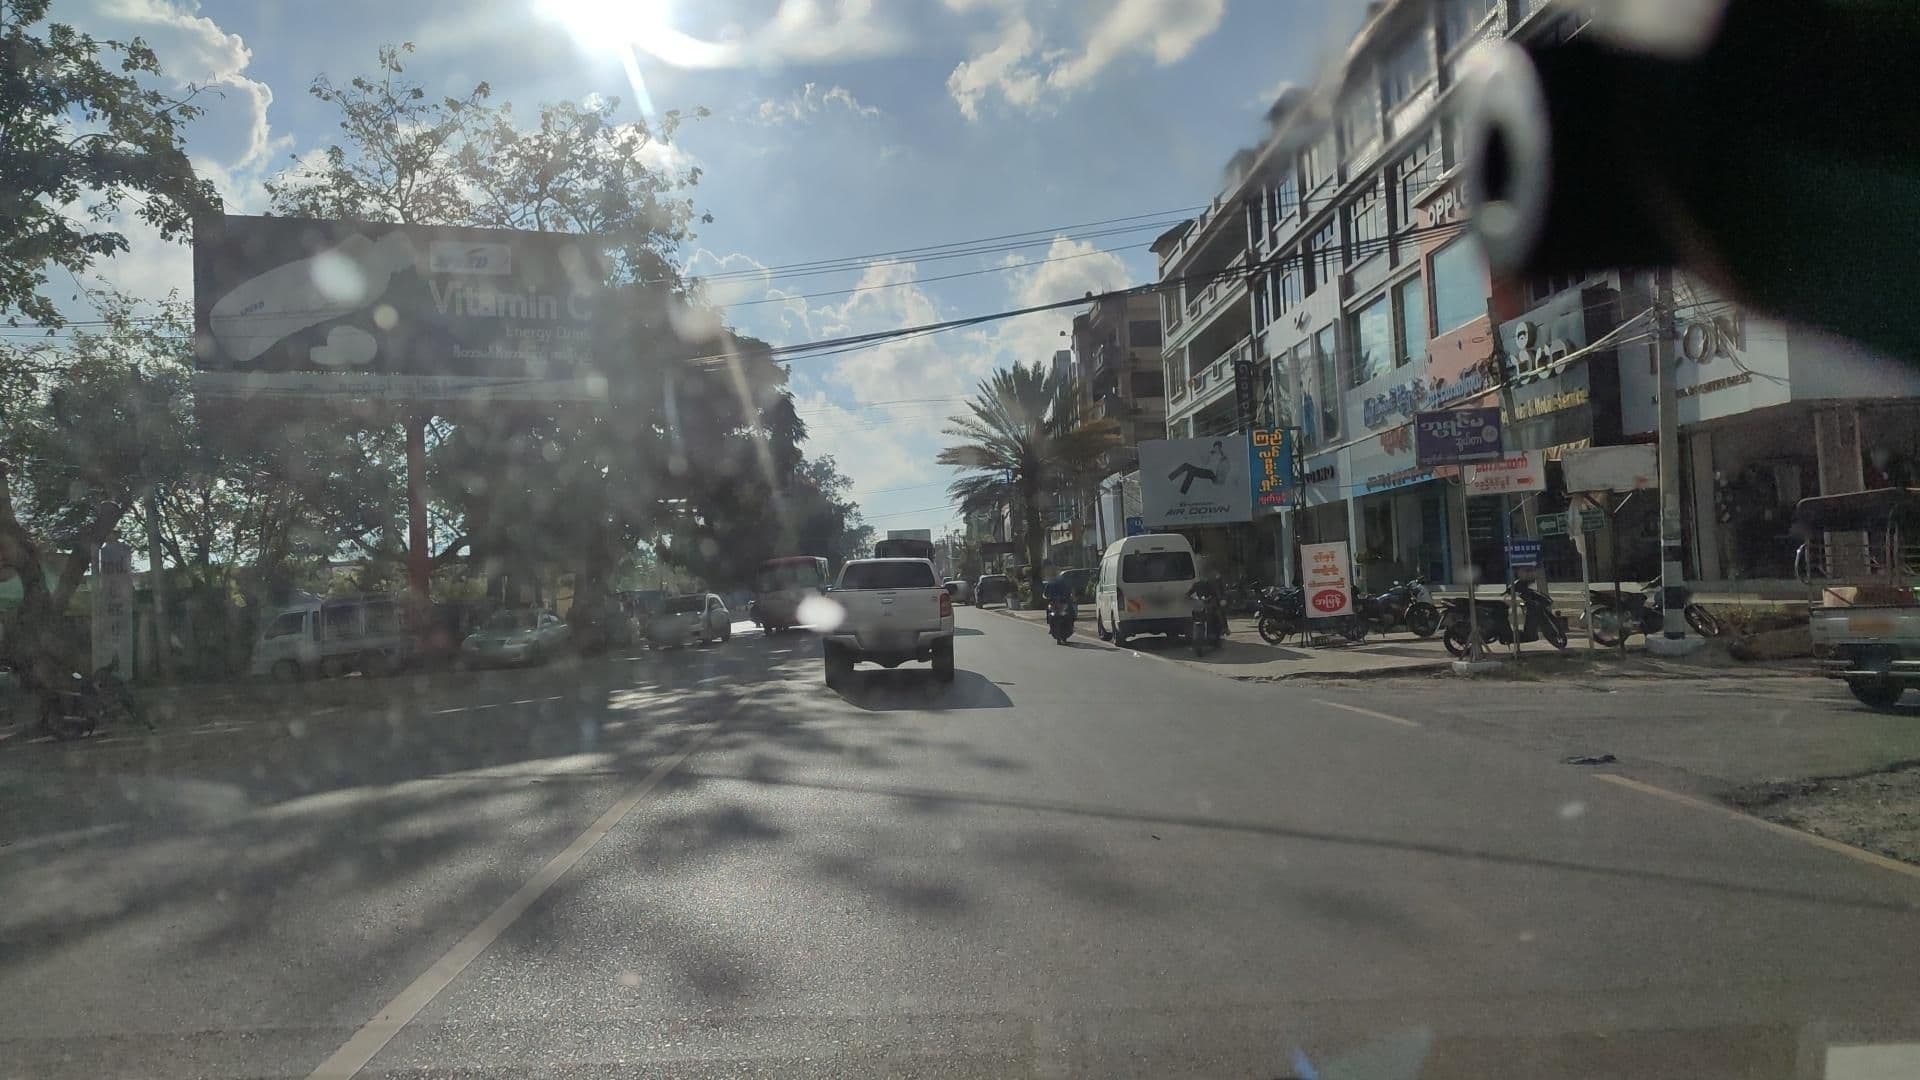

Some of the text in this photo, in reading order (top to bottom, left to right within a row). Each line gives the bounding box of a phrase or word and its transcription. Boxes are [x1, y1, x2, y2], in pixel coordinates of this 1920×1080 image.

[428, 279, 593, 321] Vitamin C
[505, 326, 552, 343] Energy
